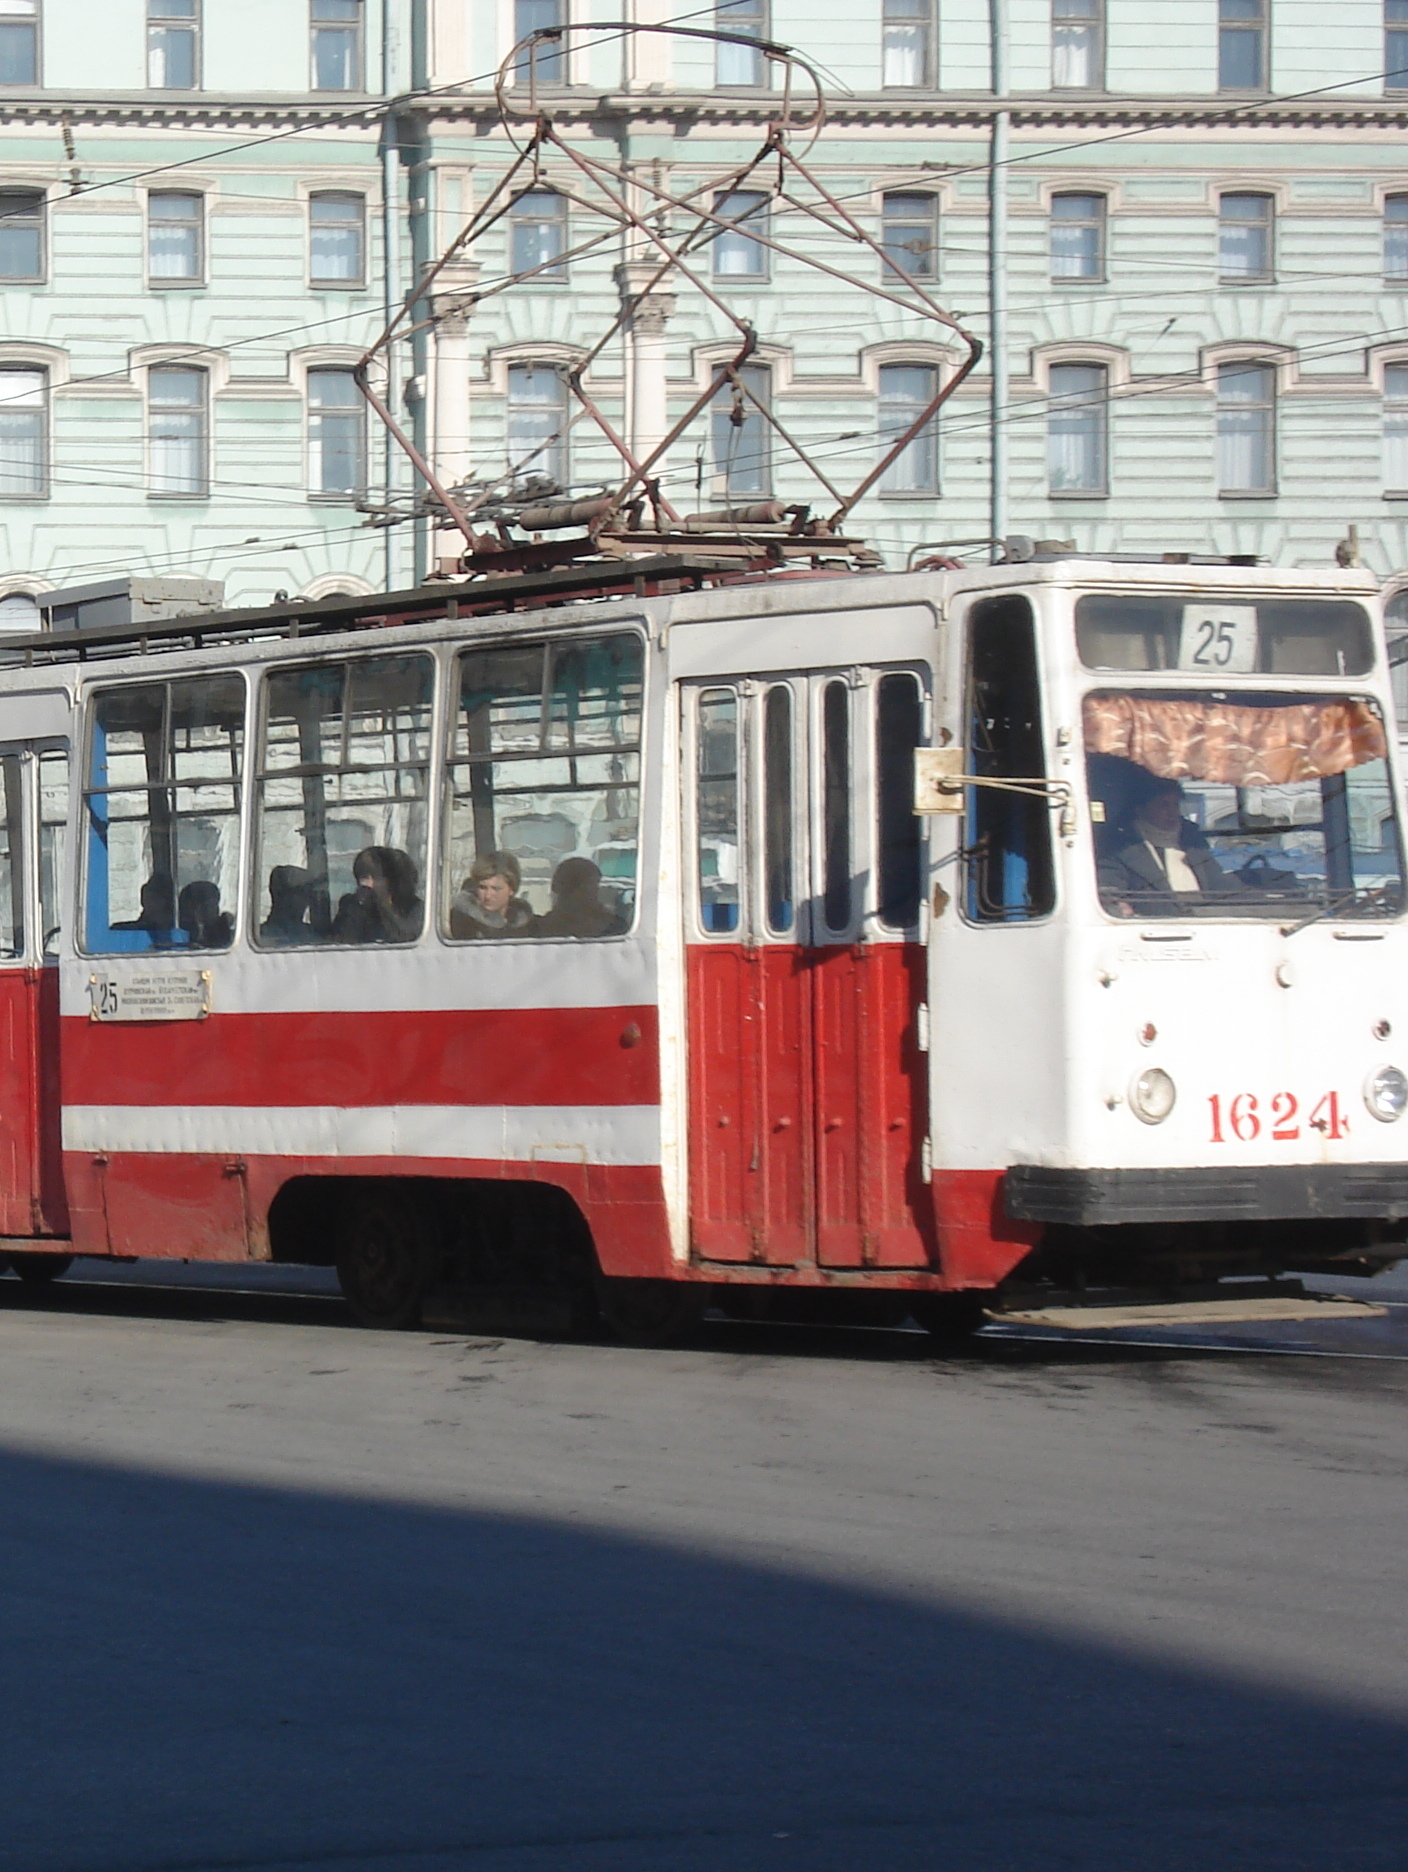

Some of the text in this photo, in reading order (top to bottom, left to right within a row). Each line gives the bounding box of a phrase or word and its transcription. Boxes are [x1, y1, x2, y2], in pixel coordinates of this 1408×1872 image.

[1193, 619, 1237, 666] 25
[100, 982, 118, 1014] 25
[1207, 1090, 1351, 1143] 1624
